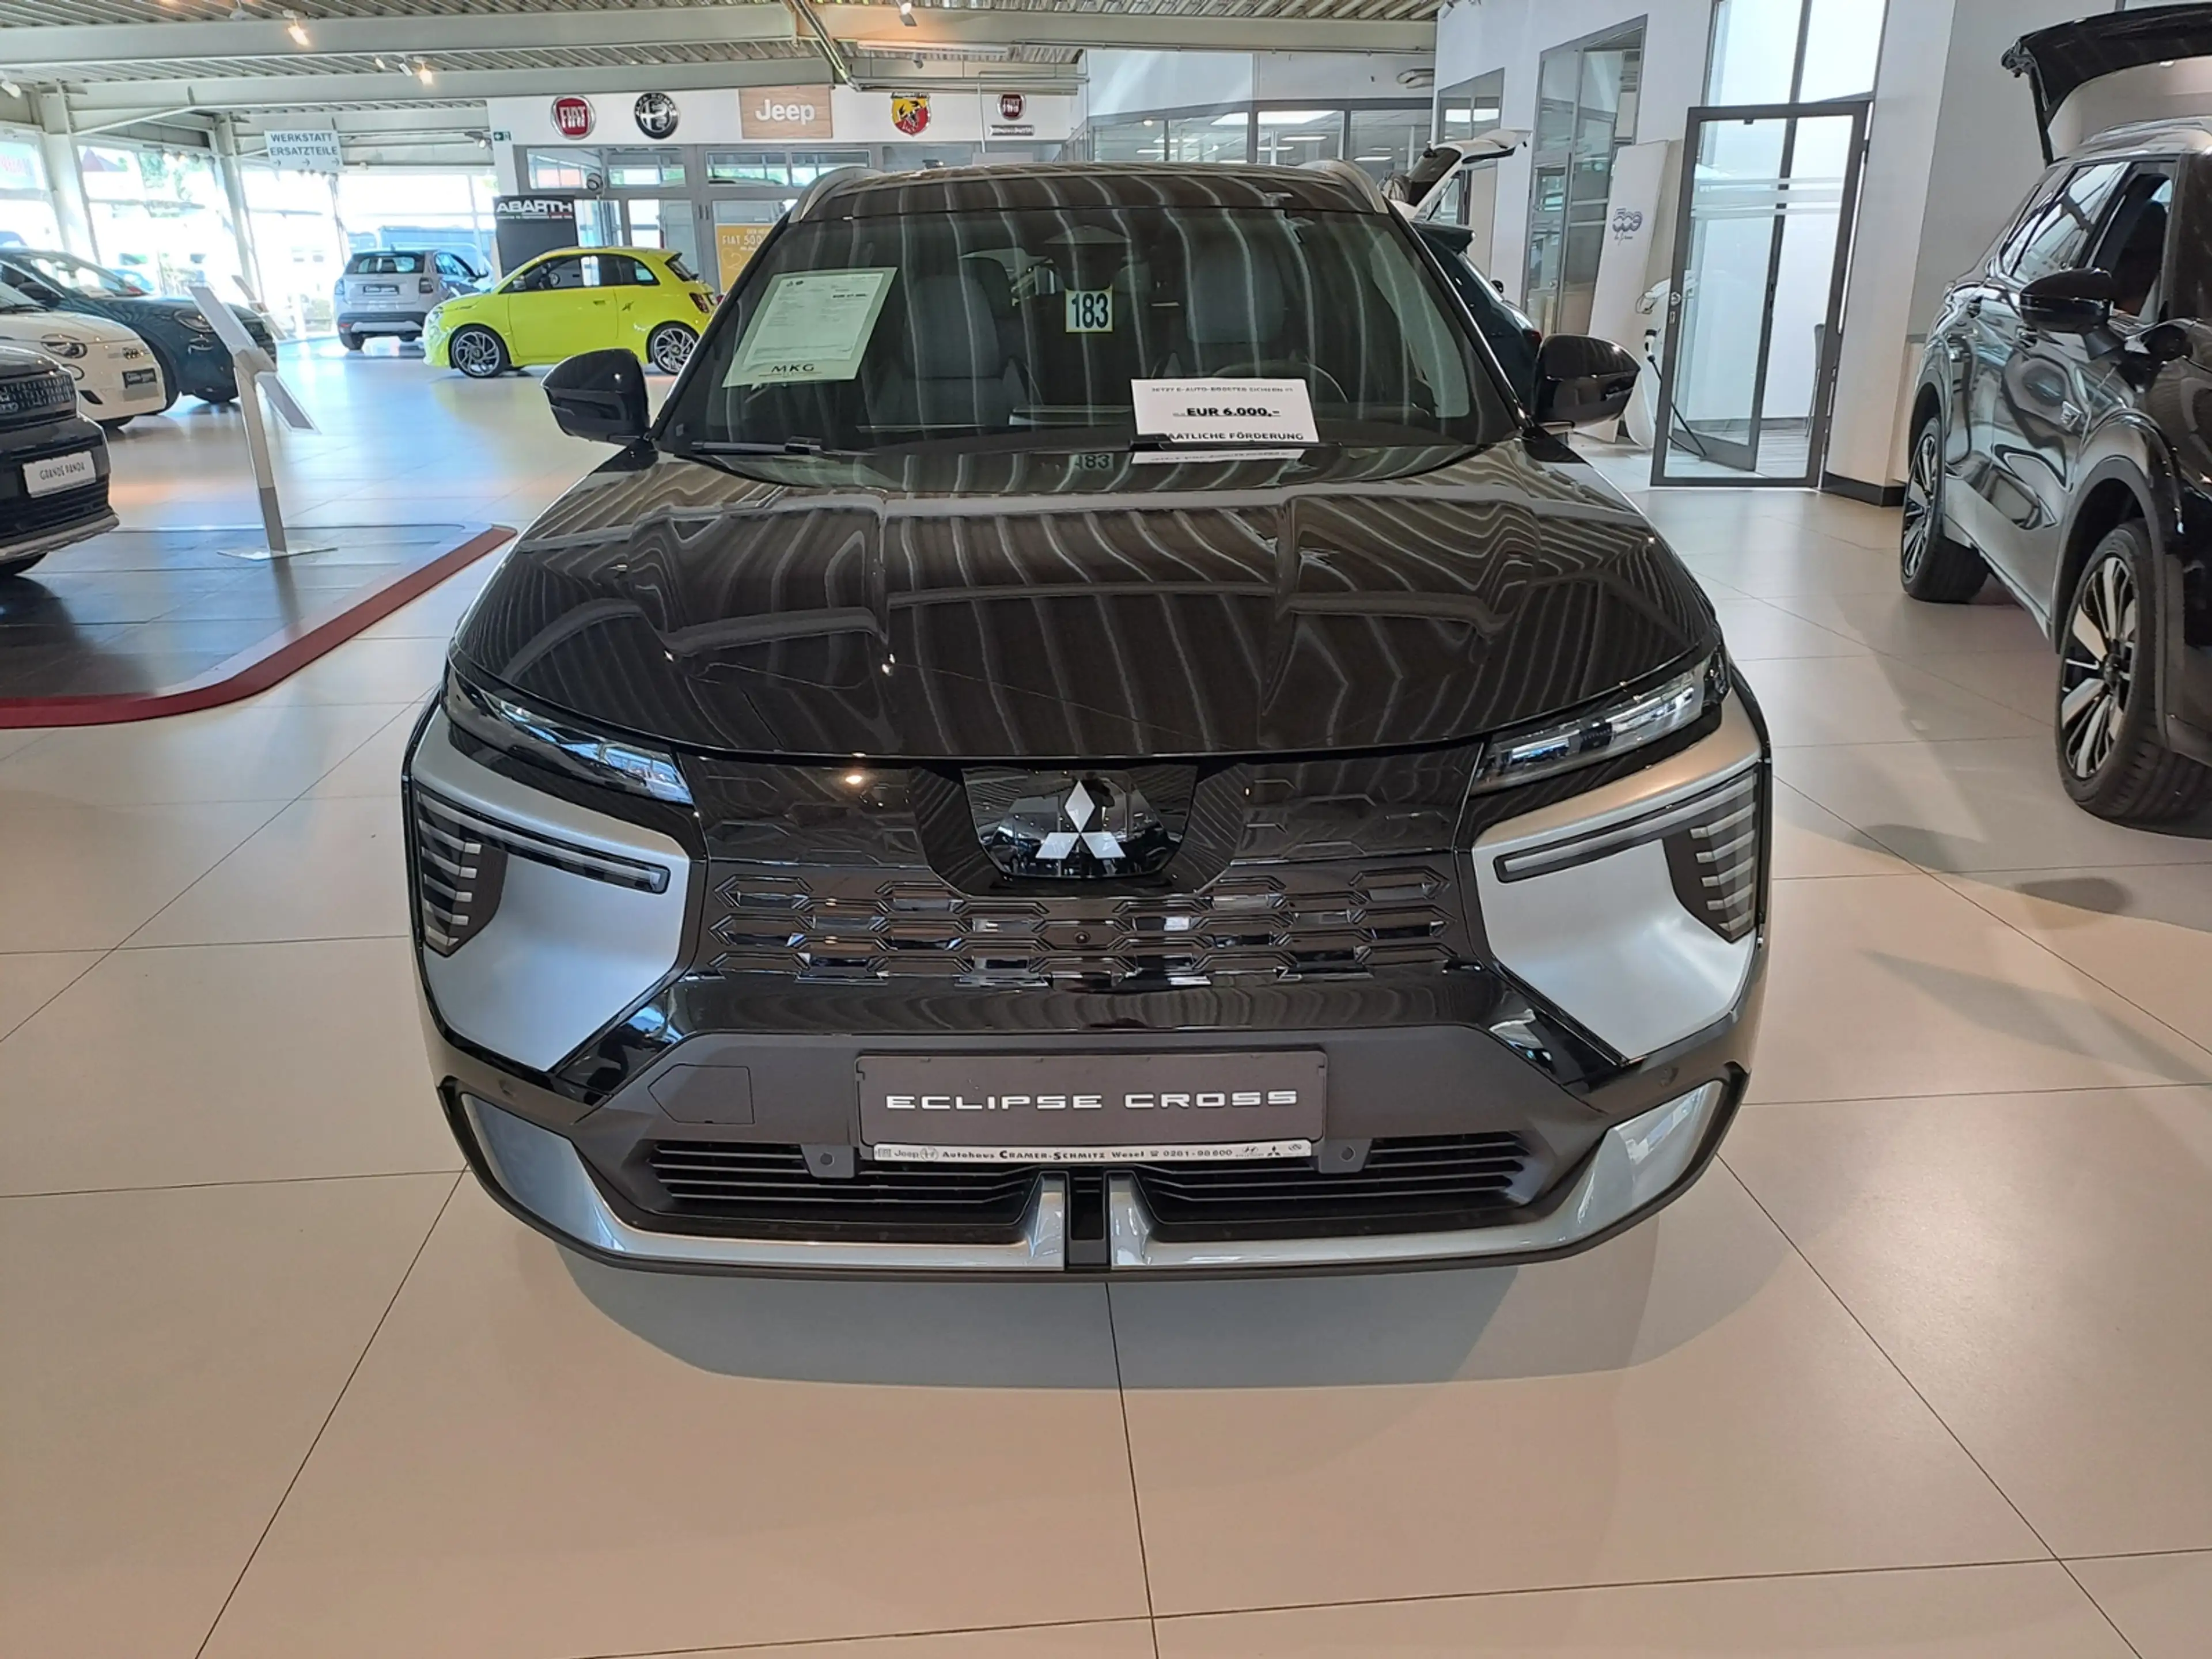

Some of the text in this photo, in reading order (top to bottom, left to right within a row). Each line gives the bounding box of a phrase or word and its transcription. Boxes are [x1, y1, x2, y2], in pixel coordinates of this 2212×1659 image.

[559, 106, 586, 128] FIAT
[755, 99, 815, 125] Jeep
[270, 132, 332, 142] WERKSTATT
[270, 146, 338, 156] ERSATZTEILE
[497, 199, 573, 213] ABARTH
[722, 235, 740, 245] FIAT
[1071, 293, 1108, 328] 183
[1187, 407, 1219, 416] EUR
[1229, 431, 1304, 440] FÖRDERUNG
[886, 1090, 1297, 1110] ECLIPSE CROSS
[942, 1151, 995, 1159] Autohaus
